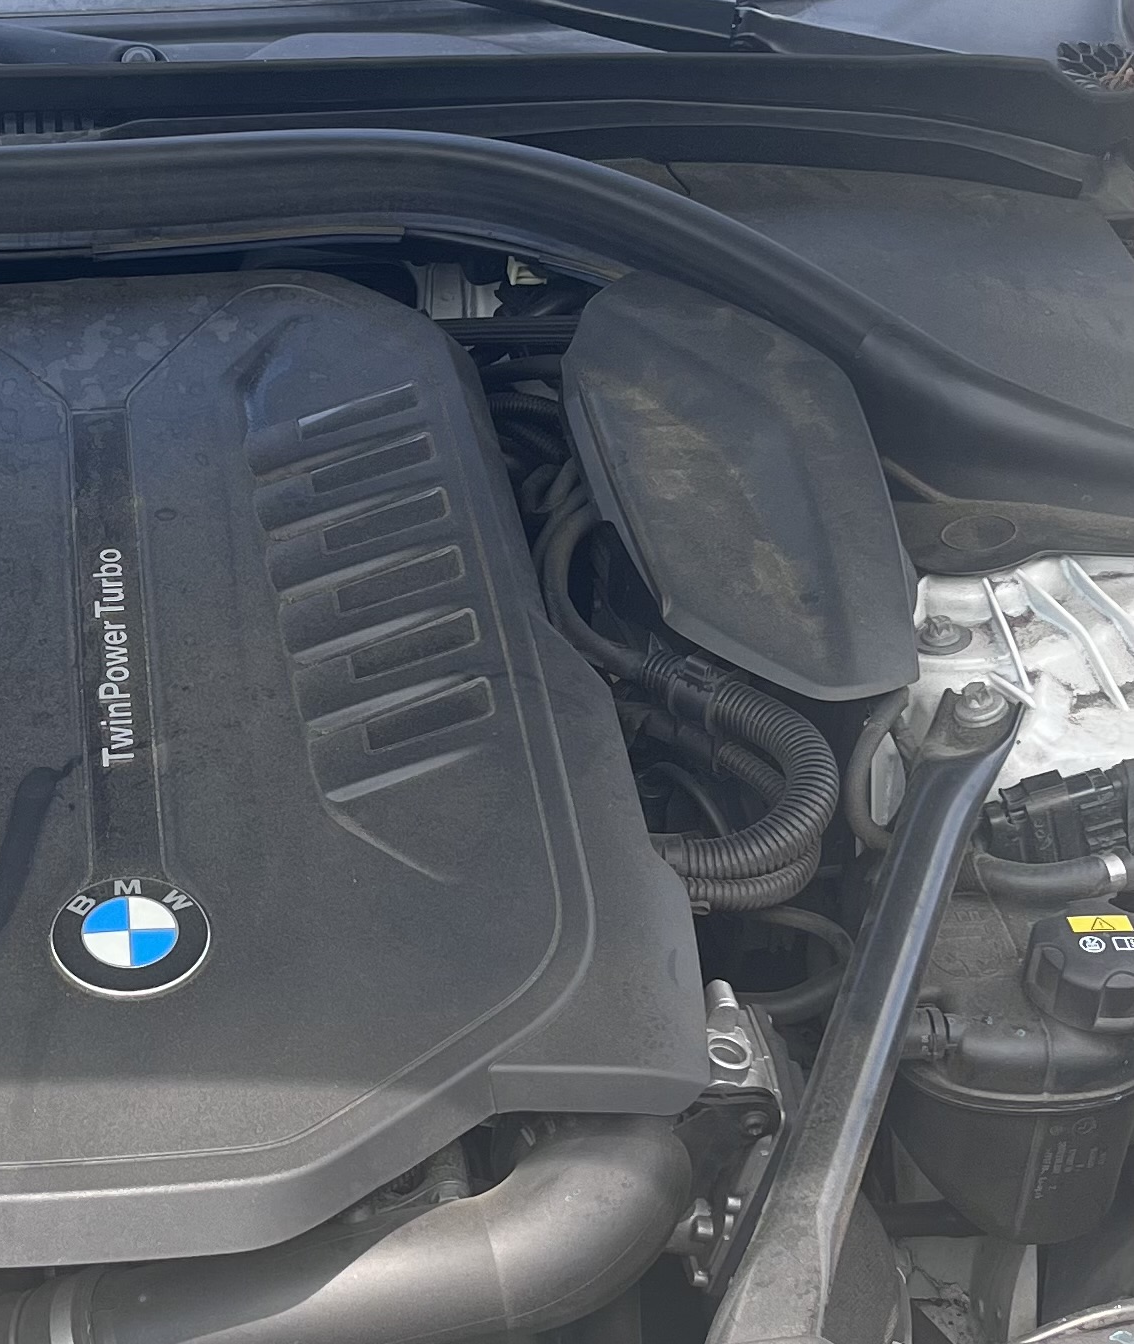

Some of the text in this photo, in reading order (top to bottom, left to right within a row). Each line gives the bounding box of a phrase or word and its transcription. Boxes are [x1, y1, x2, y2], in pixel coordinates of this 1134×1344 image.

[92, 548, 134, 767] TwinPower Turbo
[66, 878, 194, 916] BMW
